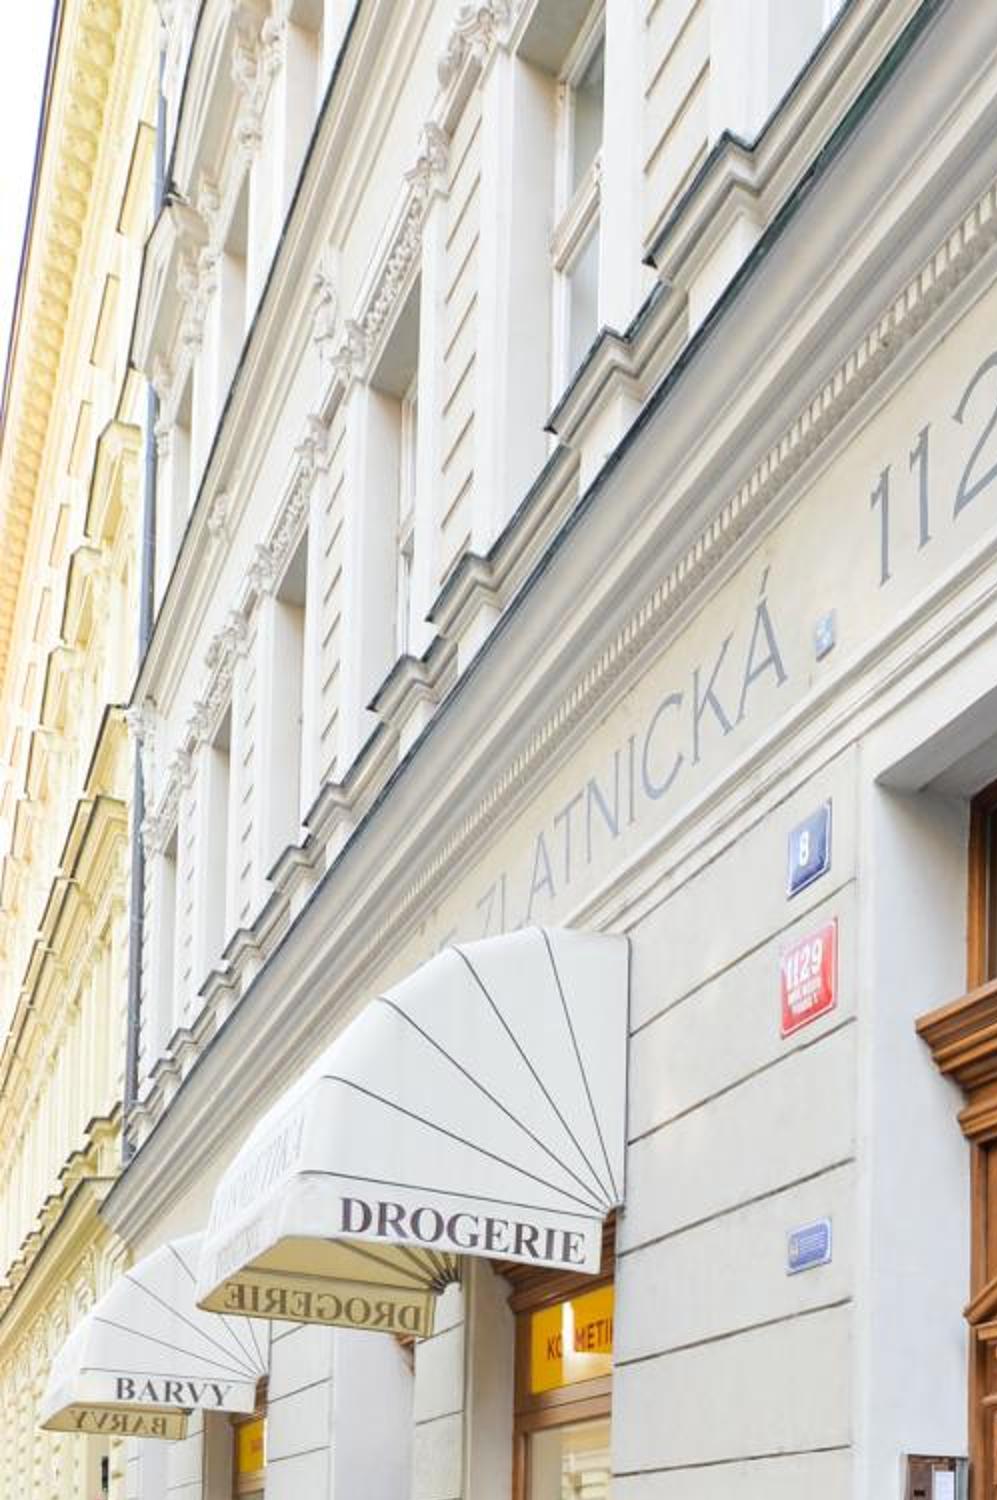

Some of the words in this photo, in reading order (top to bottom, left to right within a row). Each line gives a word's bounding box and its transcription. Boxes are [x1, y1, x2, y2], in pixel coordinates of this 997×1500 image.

[799, 831, 809, 866] 8
[786, 939, 822, 993] 1129
[339, 1198, 586, 1265] DROGERIE
[116, 1377, 232, 1407] BARVY
